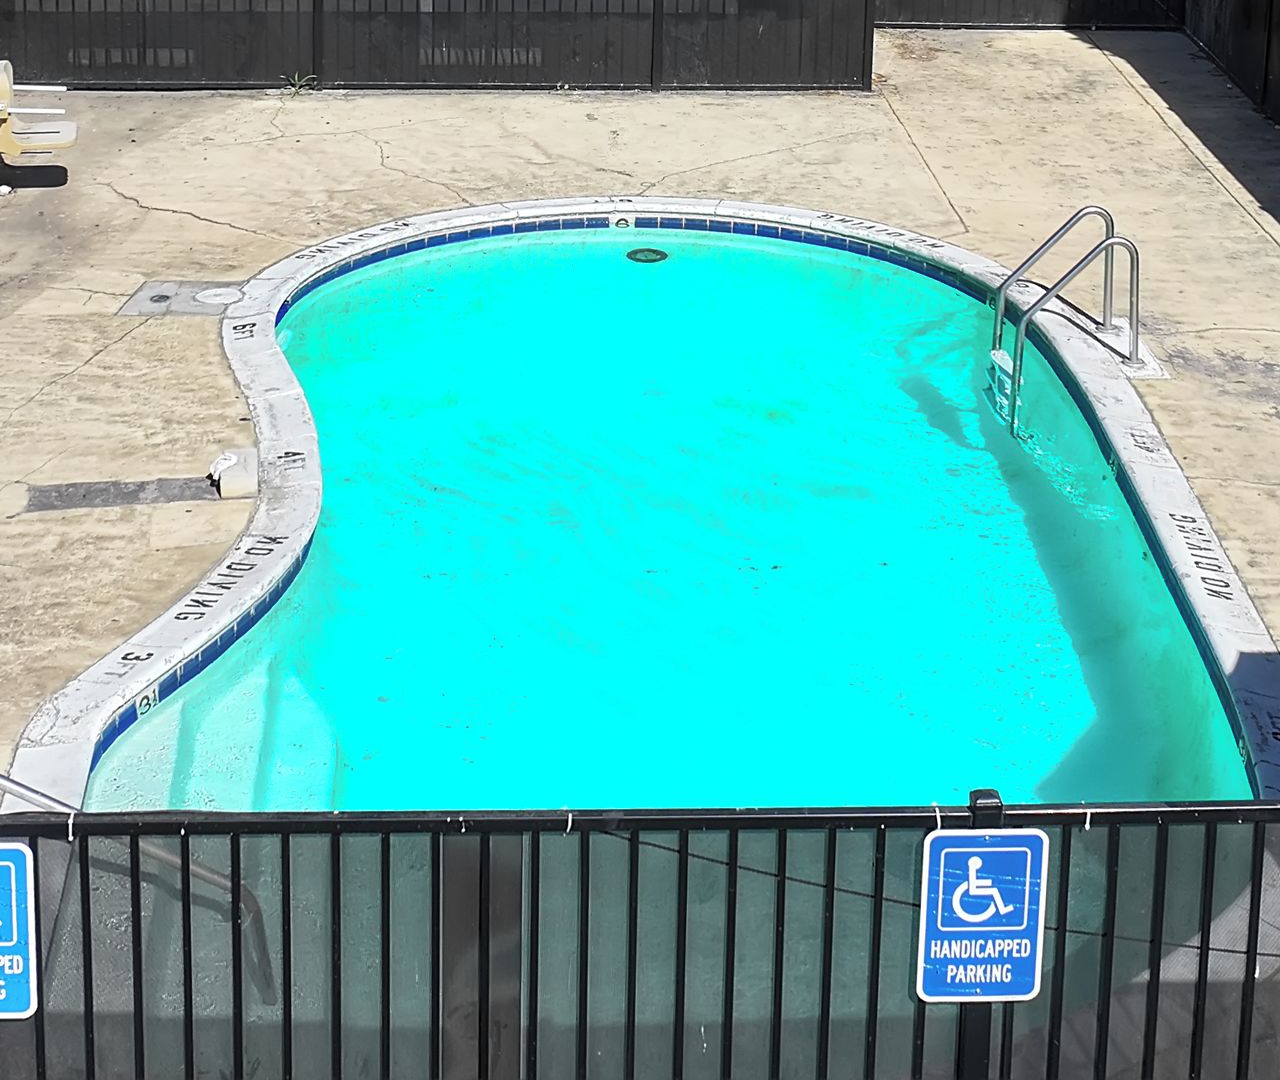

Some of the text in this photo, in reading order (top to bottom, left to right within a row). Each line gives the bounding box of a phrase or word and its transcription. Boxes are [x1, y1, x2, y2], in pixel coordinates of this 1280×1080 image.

[173, 535, 290, 622] NO DIVING
[1168, 512, 1235, 602] NO DIVING
[930, 938, 1031, 959] HANDICAPPED
[946, 963, 1012, 984] PARKING
